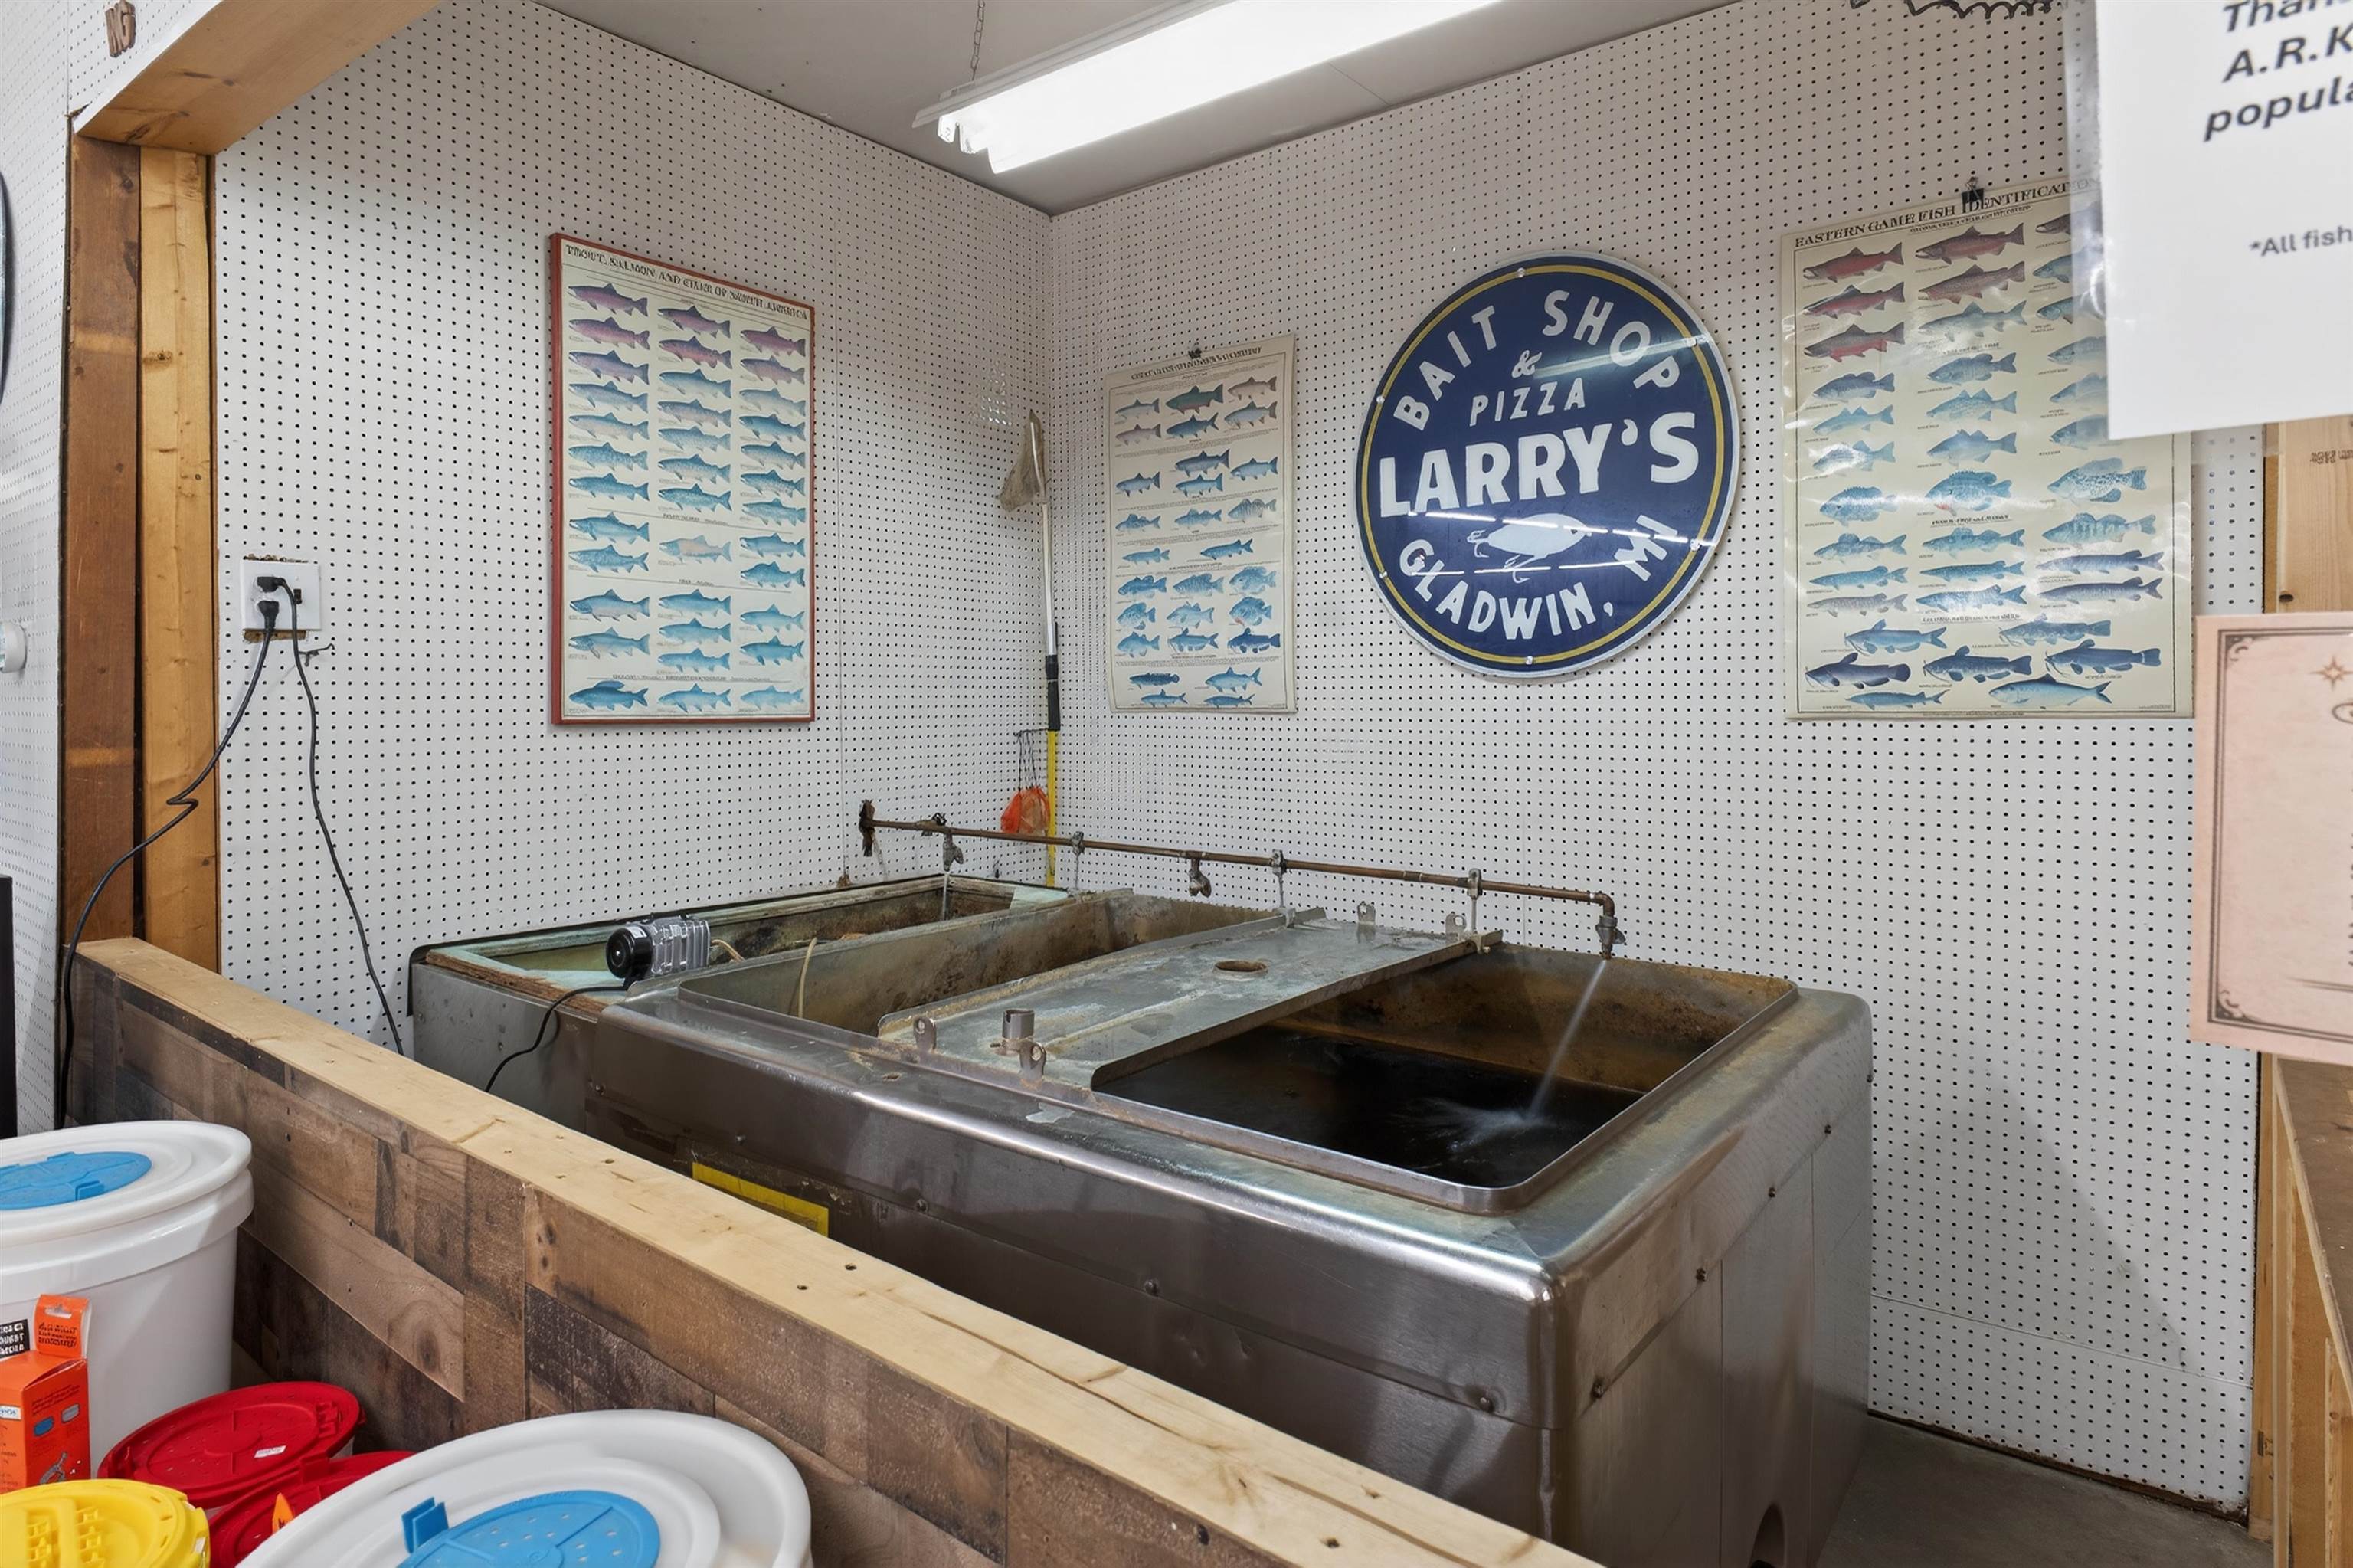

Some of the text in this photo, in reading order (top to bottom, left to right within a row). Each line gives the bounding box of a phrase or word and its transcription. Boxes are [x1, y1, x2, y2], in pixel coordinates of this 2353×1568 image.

[2223, 0, 2353, 32] Tha
[1795, 223, 1866, 248] EASTERN
[1868, 214, 1915, 231] GAME
[1918, 205, 1955, 222] FISH
[2303, 224, 2353, 249] fish
[1393, 290, 1680, 430] BAIT SHOP
[1511, 350, 1543, 378] &
[1469, 378, 1586, 427] PIZZA
[1379, 411, 1699, 517] LARRY'S
[1399, 514, 1679, 640] GLADWIN, MI
